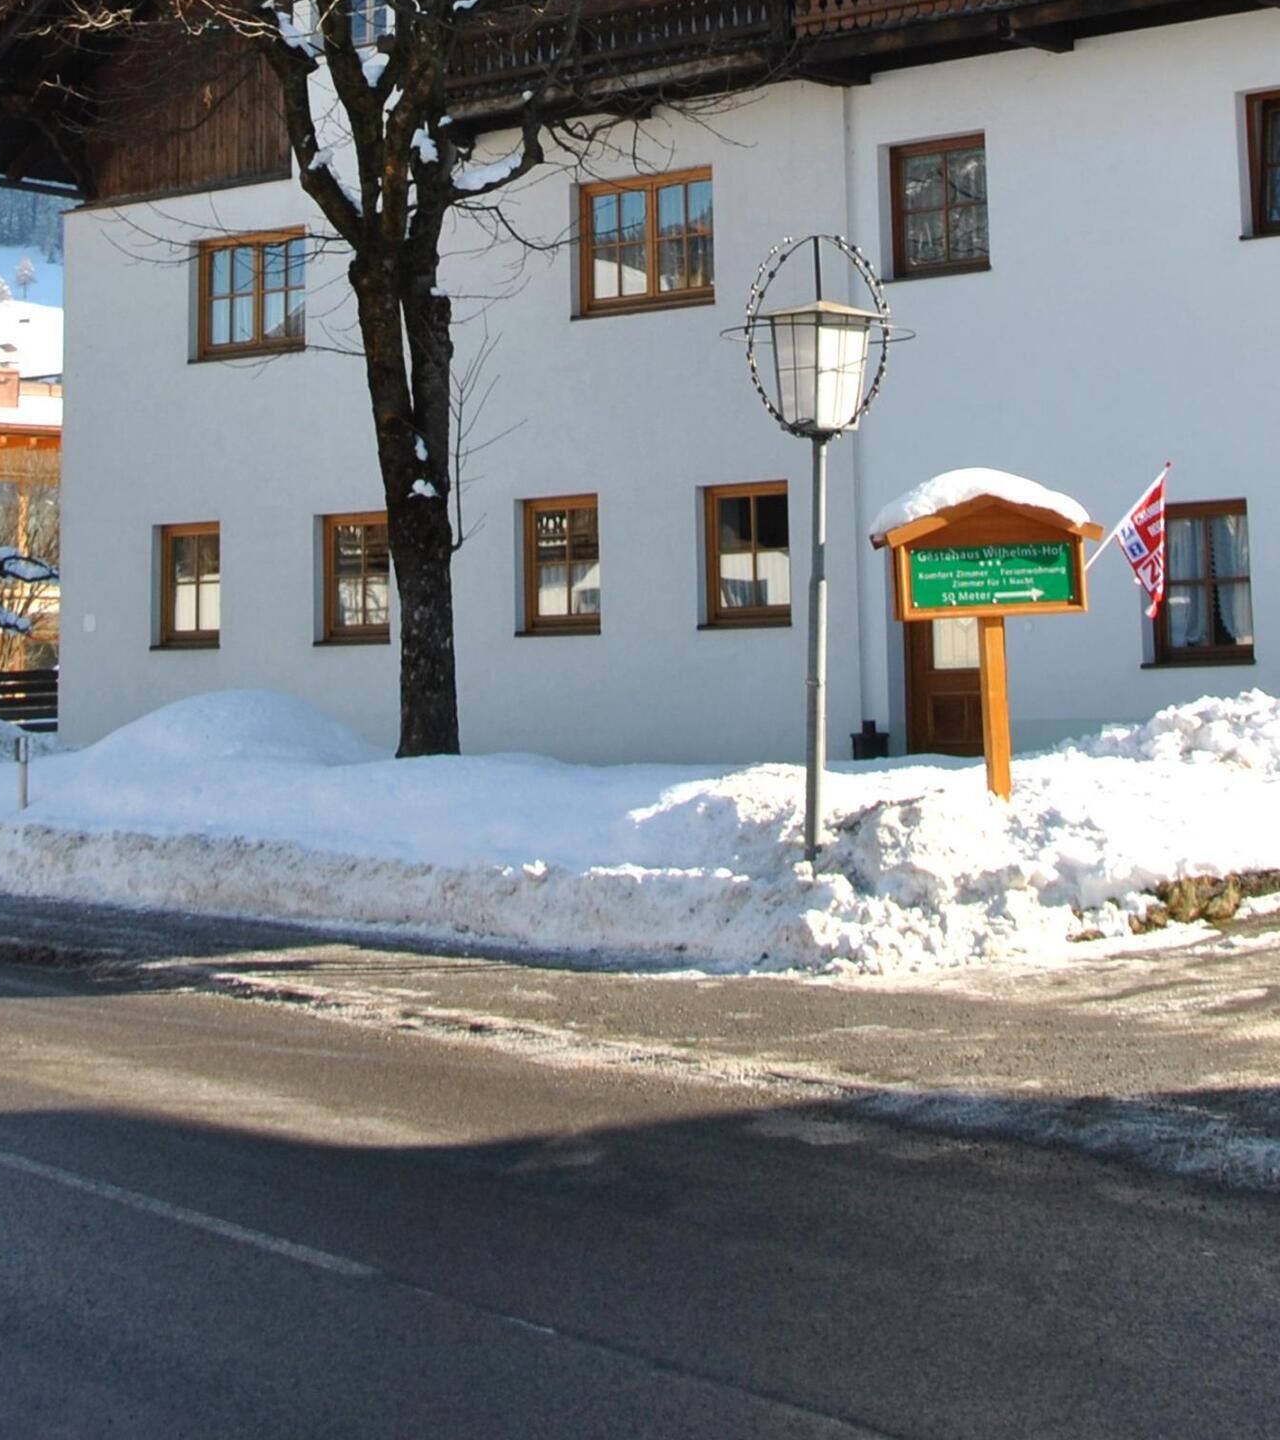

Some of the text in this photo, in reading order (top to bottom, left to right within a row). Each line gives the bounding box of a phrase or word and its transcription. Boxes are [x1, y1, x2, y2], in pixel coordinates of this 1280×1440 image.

[956, 569, 988, 579] Zimmer
[952, 579, 985, 589] Zimmer
[958, 591, 991, 601] Meter
